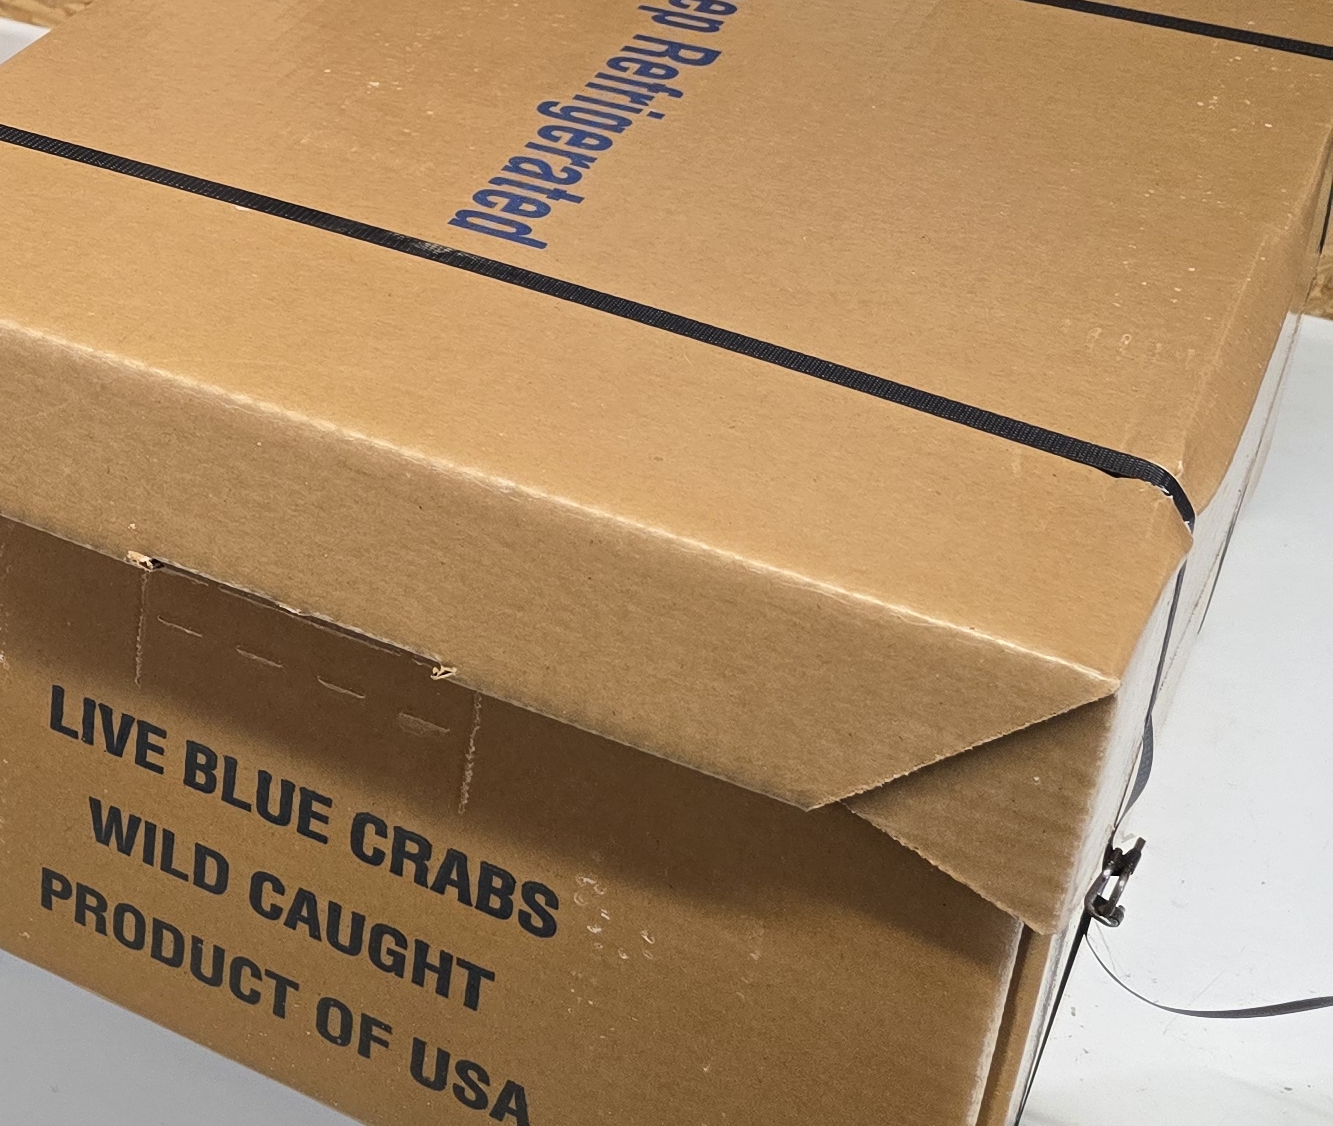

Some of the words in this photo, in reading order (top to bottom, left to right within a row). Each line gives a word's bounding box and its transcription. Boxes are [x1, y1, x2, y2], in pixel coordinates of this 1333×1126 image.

[447, 34, 722, 250] Refrigerated
[49, 684, 167, 775] LIVE
[183, 739, 333, 845] BLUE
[349, 811, 560, 940] CRABS
[88, 795, 230, 896] WILD
[249, 870, 496, 1012] CAUGHT
[39, 866, 299, 1020] PRODUCT
[316, 995, 393, 1060] OF
[409, 1036, 531, 1126] USA
